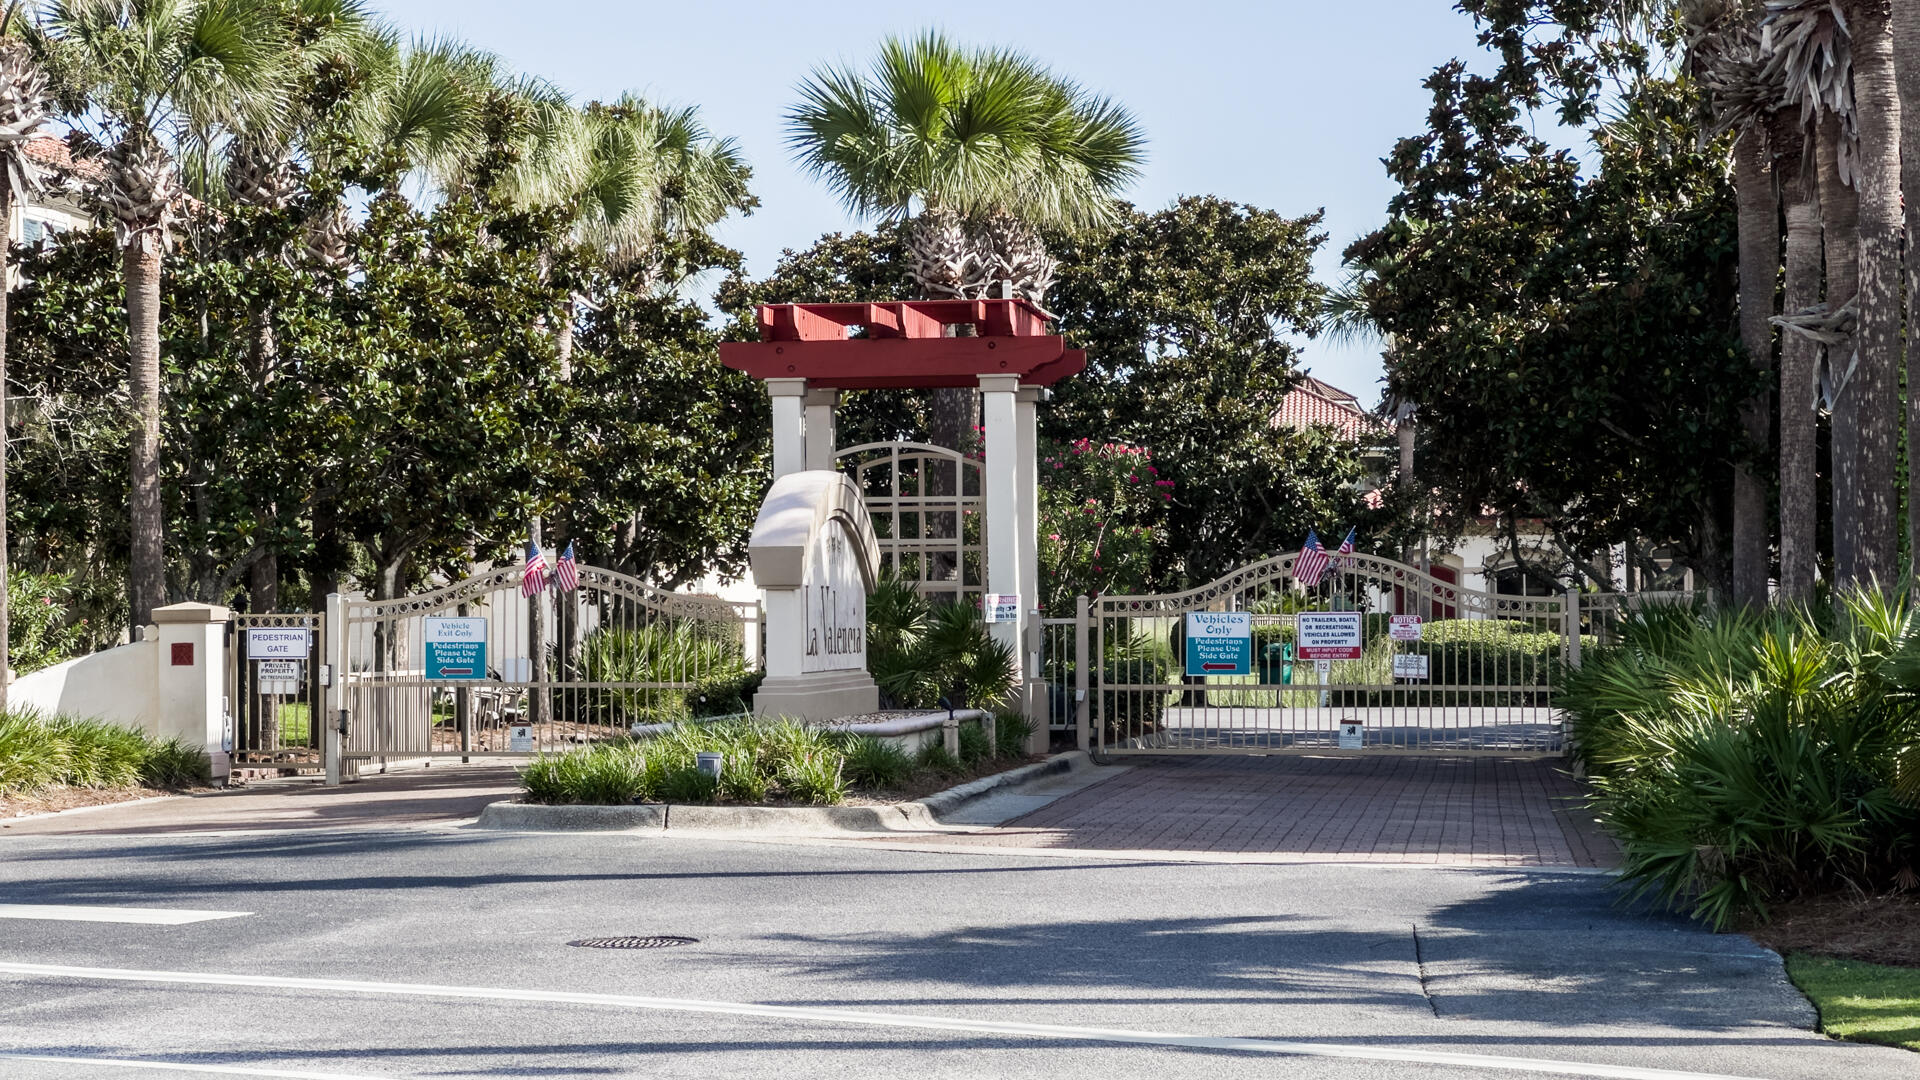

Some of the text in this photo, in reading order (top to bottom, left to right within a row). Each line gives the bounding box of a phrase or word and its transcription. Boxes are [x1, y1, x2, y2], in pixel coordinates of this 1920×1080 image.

[805, 585, 862, 656] La Valencia
[1195, 614, 1244, 624] Vehicles
[1393, 616, 1418, 624] NOTICE
[441, 622, 470, 630] Vehicle
[1206, 625, 1232, 636] Only
[455, 630, 473, 638] Only
